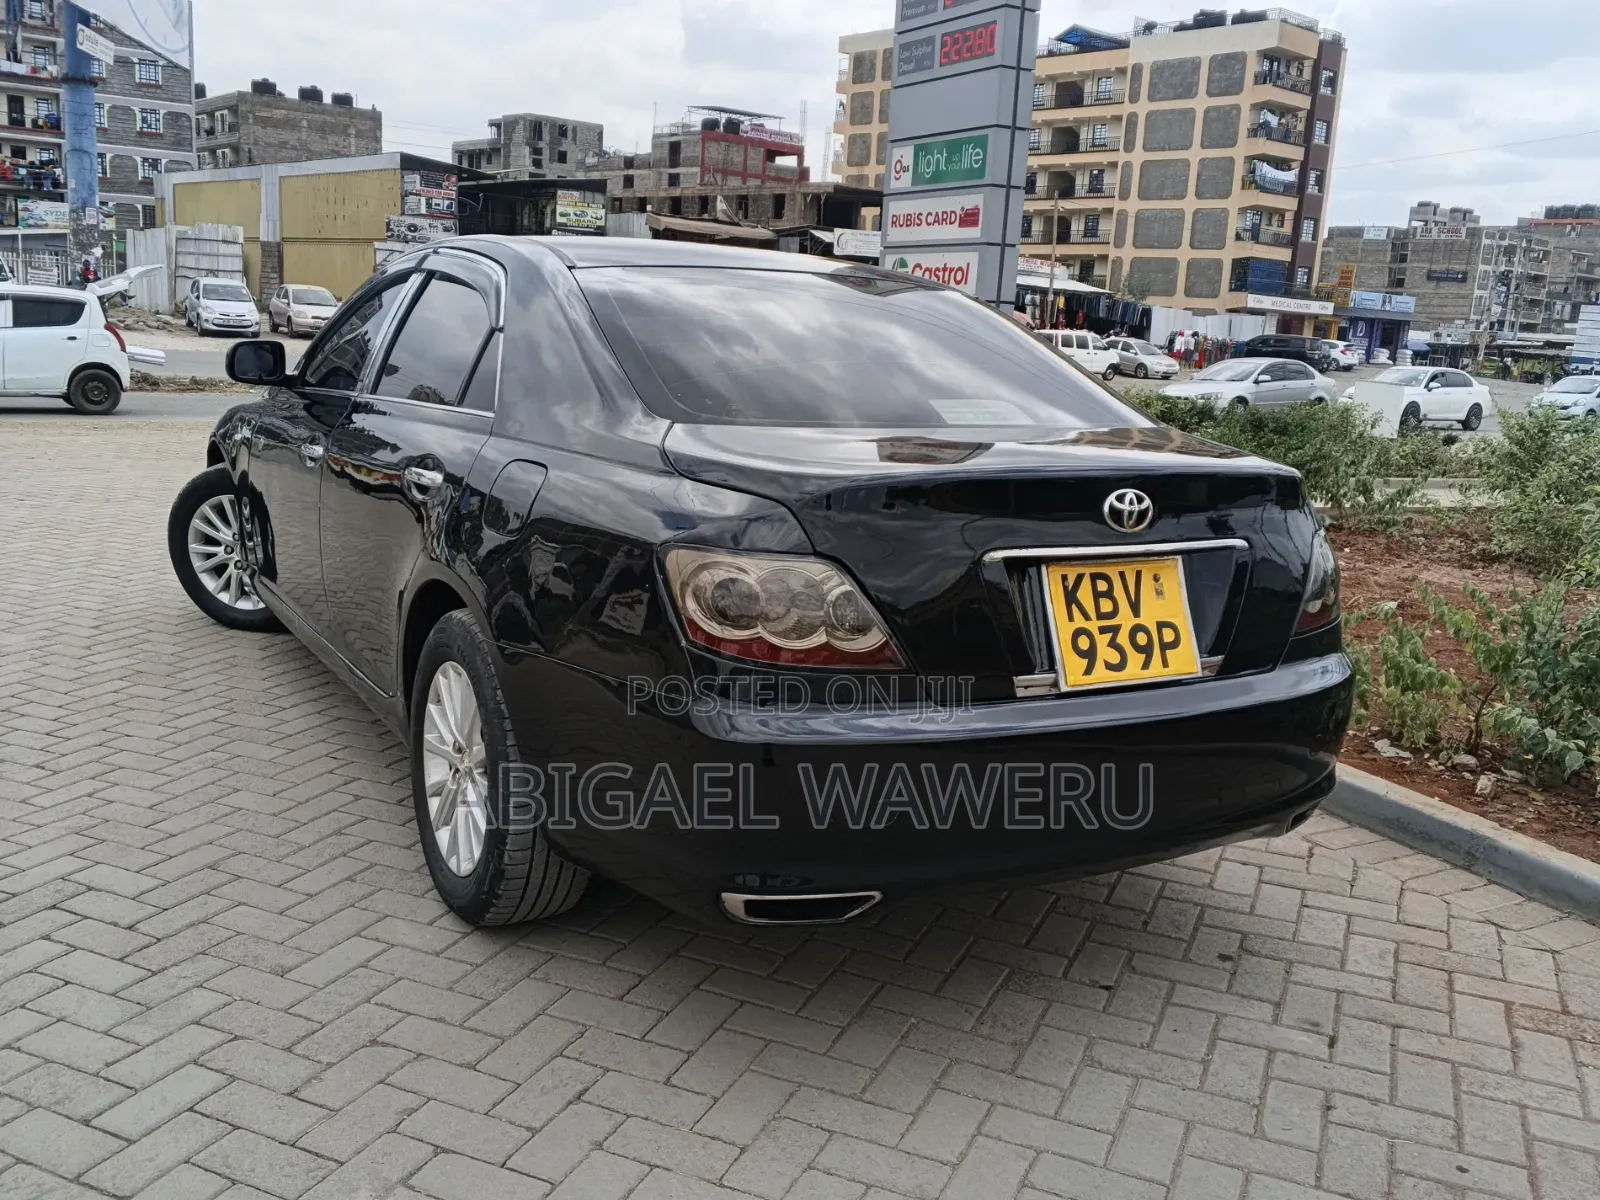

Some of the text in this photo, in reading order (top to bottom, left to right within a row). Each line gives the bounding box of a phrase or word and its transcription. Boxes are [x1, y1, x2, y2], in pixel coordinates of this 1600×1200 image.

[902, 5, 926, 17] Premium
[900, 43, 932, 59] Low Sulphur
[941, 24, 998, 64] 222.80
[900, 58, 916, 72] Diesel
[894, 154, 910, 180] gas
[918, 147, 948, 178] light
[961, 143, 984, 169] life
[566, 217, 597, 225] SUBARU
[925, 210, 957, 226] CARD
[1420, 227, 1463, 235] ARK SCHOOL
[1271, 300, 1292, 309] MEDICAL
[1293, 302, 1312, 310] CENTRE
[1061, 570, 1143, 622] KBV
[1071, 621, 1182, 676] 939P
